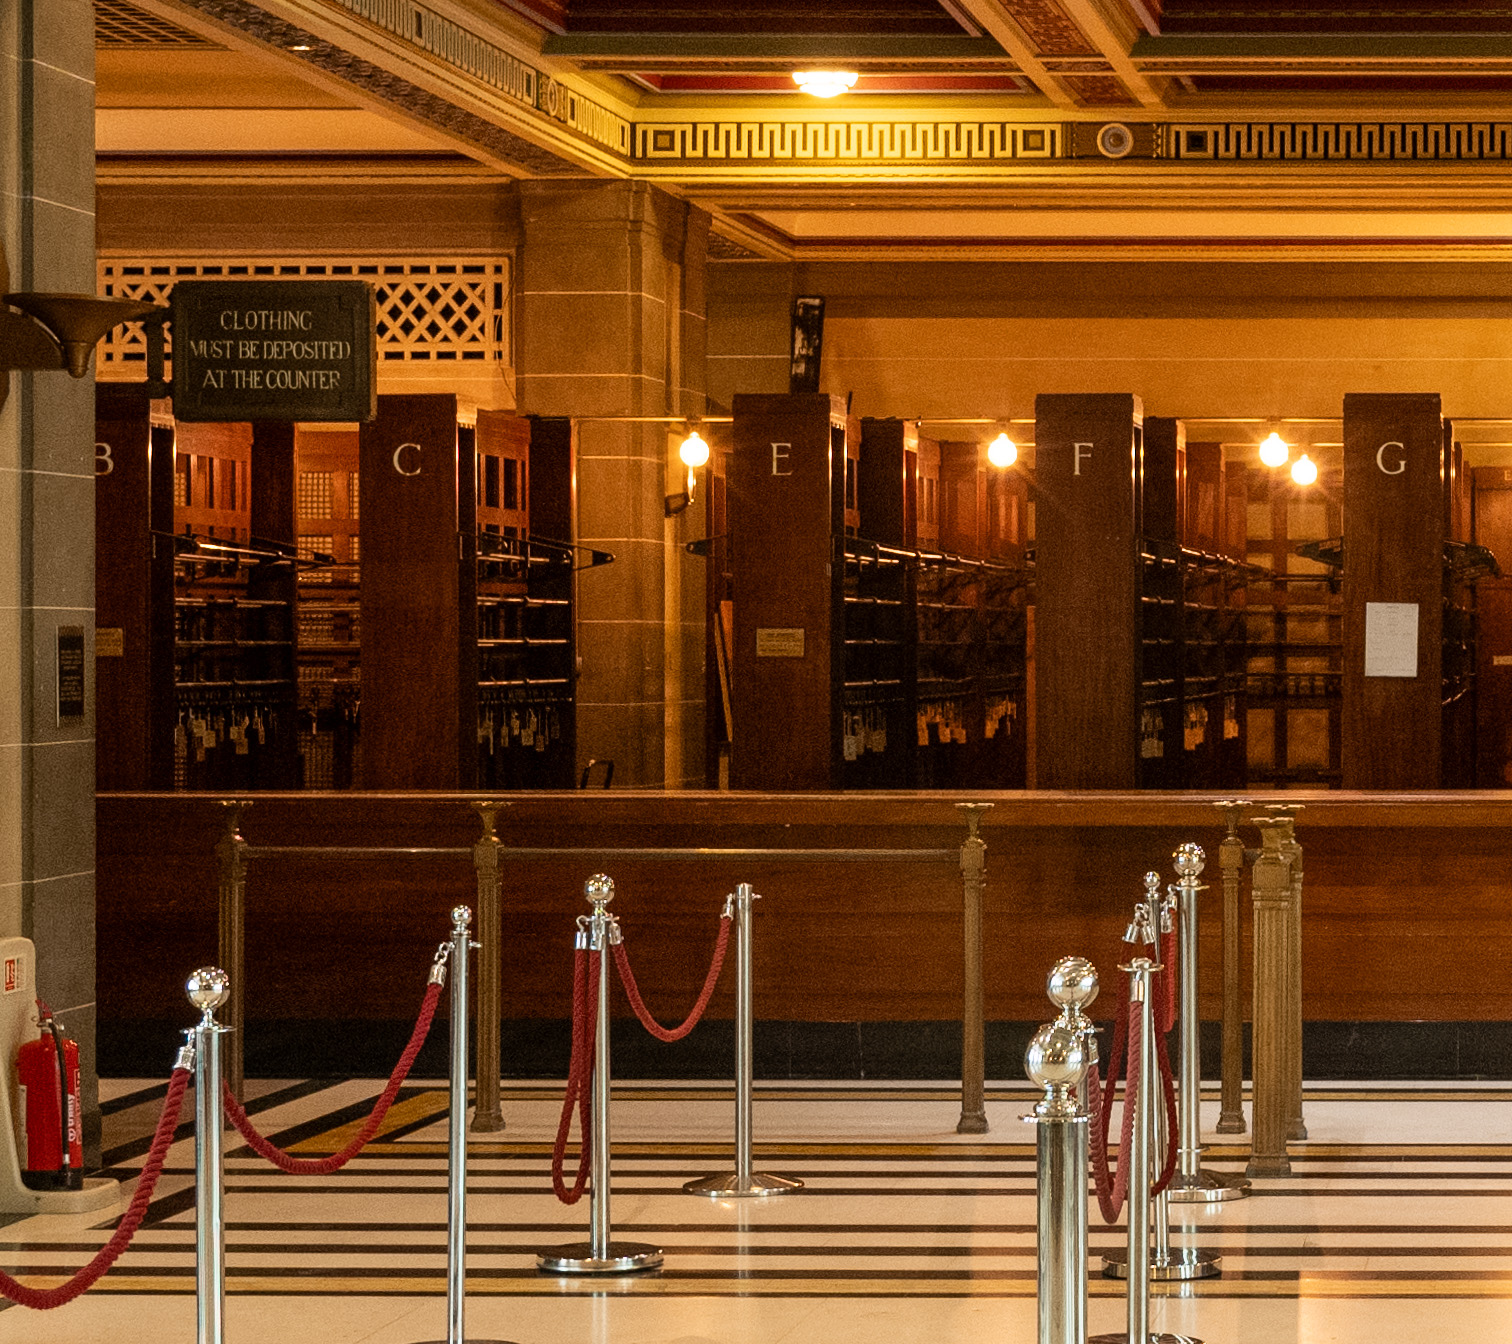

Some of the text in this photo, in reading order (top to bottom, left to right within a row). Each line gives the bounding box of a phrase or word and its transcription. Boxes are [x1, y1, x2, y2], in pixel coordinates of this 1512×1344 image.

[220, 310, 312, 331] CLOTHING
[190, 340, 351, 360] MUST BE DEPOSITED
[202, 369, 341, 390] AT THE COUNTER
[393, 443, 422, 477] C
[770, 442, 793, 476] E
[1072, 442, 1094, 476] F
[1376, 441, 1406, 475] G
